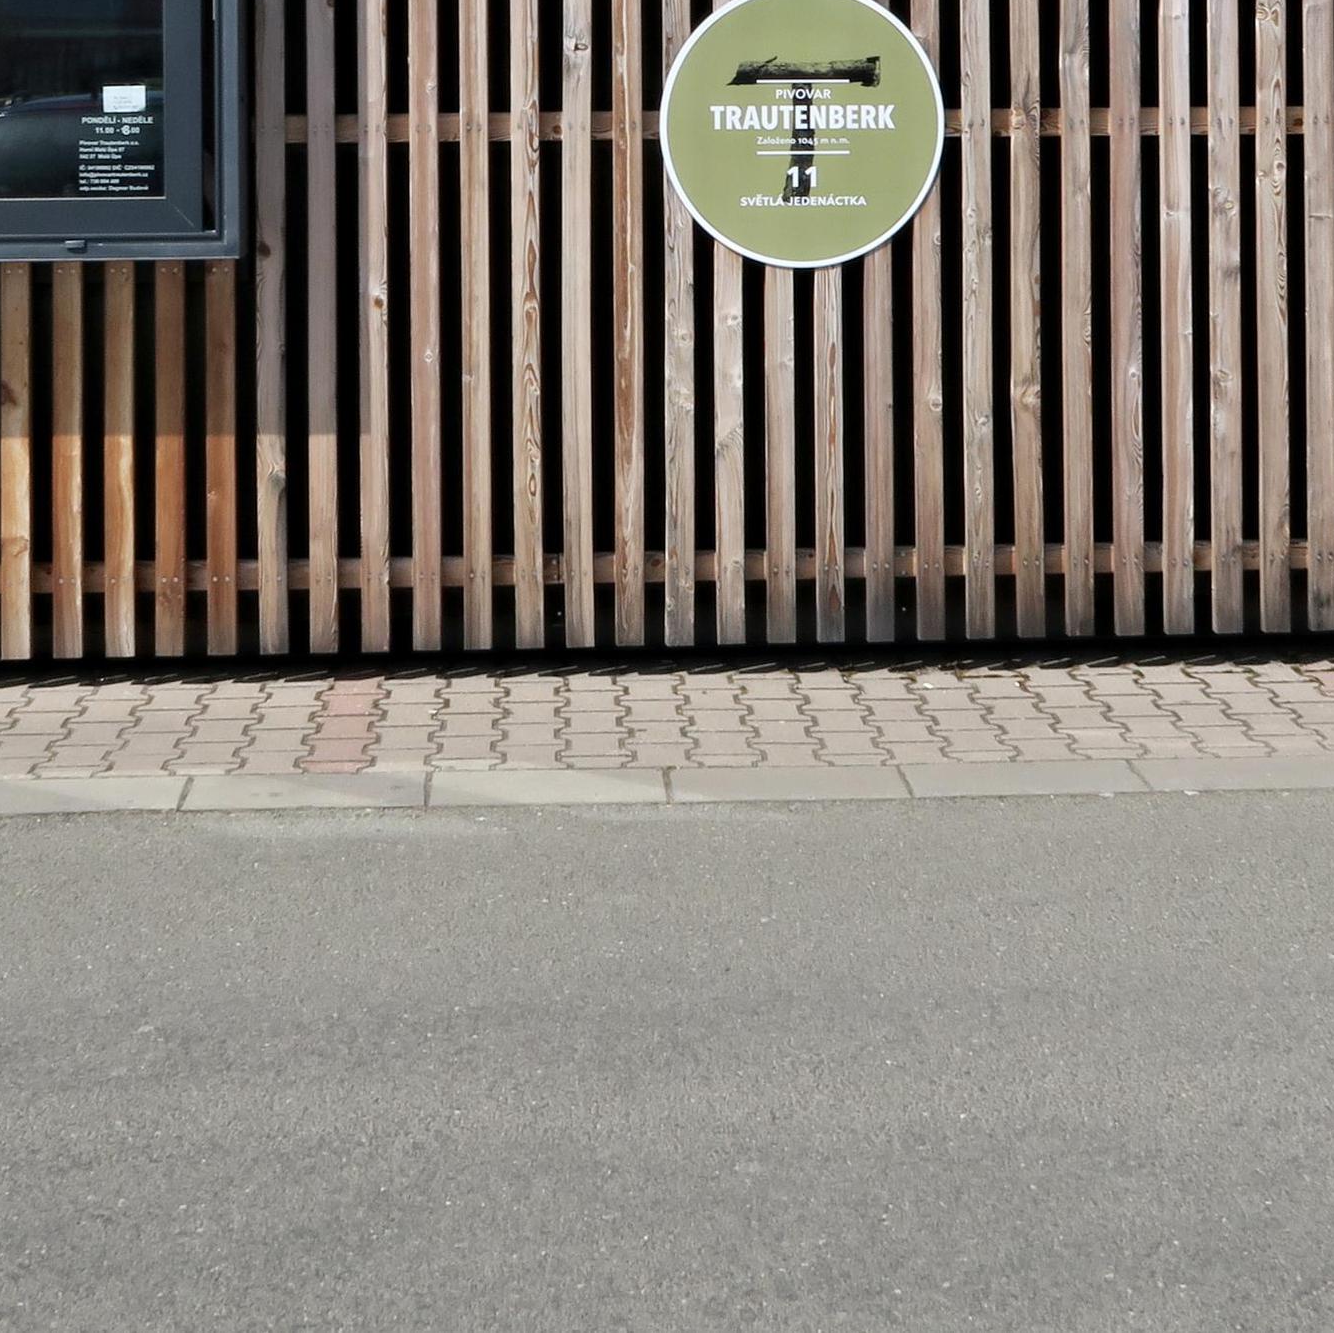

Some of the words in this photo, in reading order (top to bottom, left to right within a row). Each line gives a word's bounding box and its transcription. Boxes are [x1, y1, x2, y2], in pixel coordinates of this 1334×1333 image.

[775, 88, 832, 100] PIVOVAR
[709, 104, 896, 131] TRAUTENBERK
[756, 136, 796, 145] Založeno
[786, 166, 818, 188] 11
[740, 193, 785, 207] SVĚTLÁ
[788, 193, 867, 207] JEDENÁCTKA
